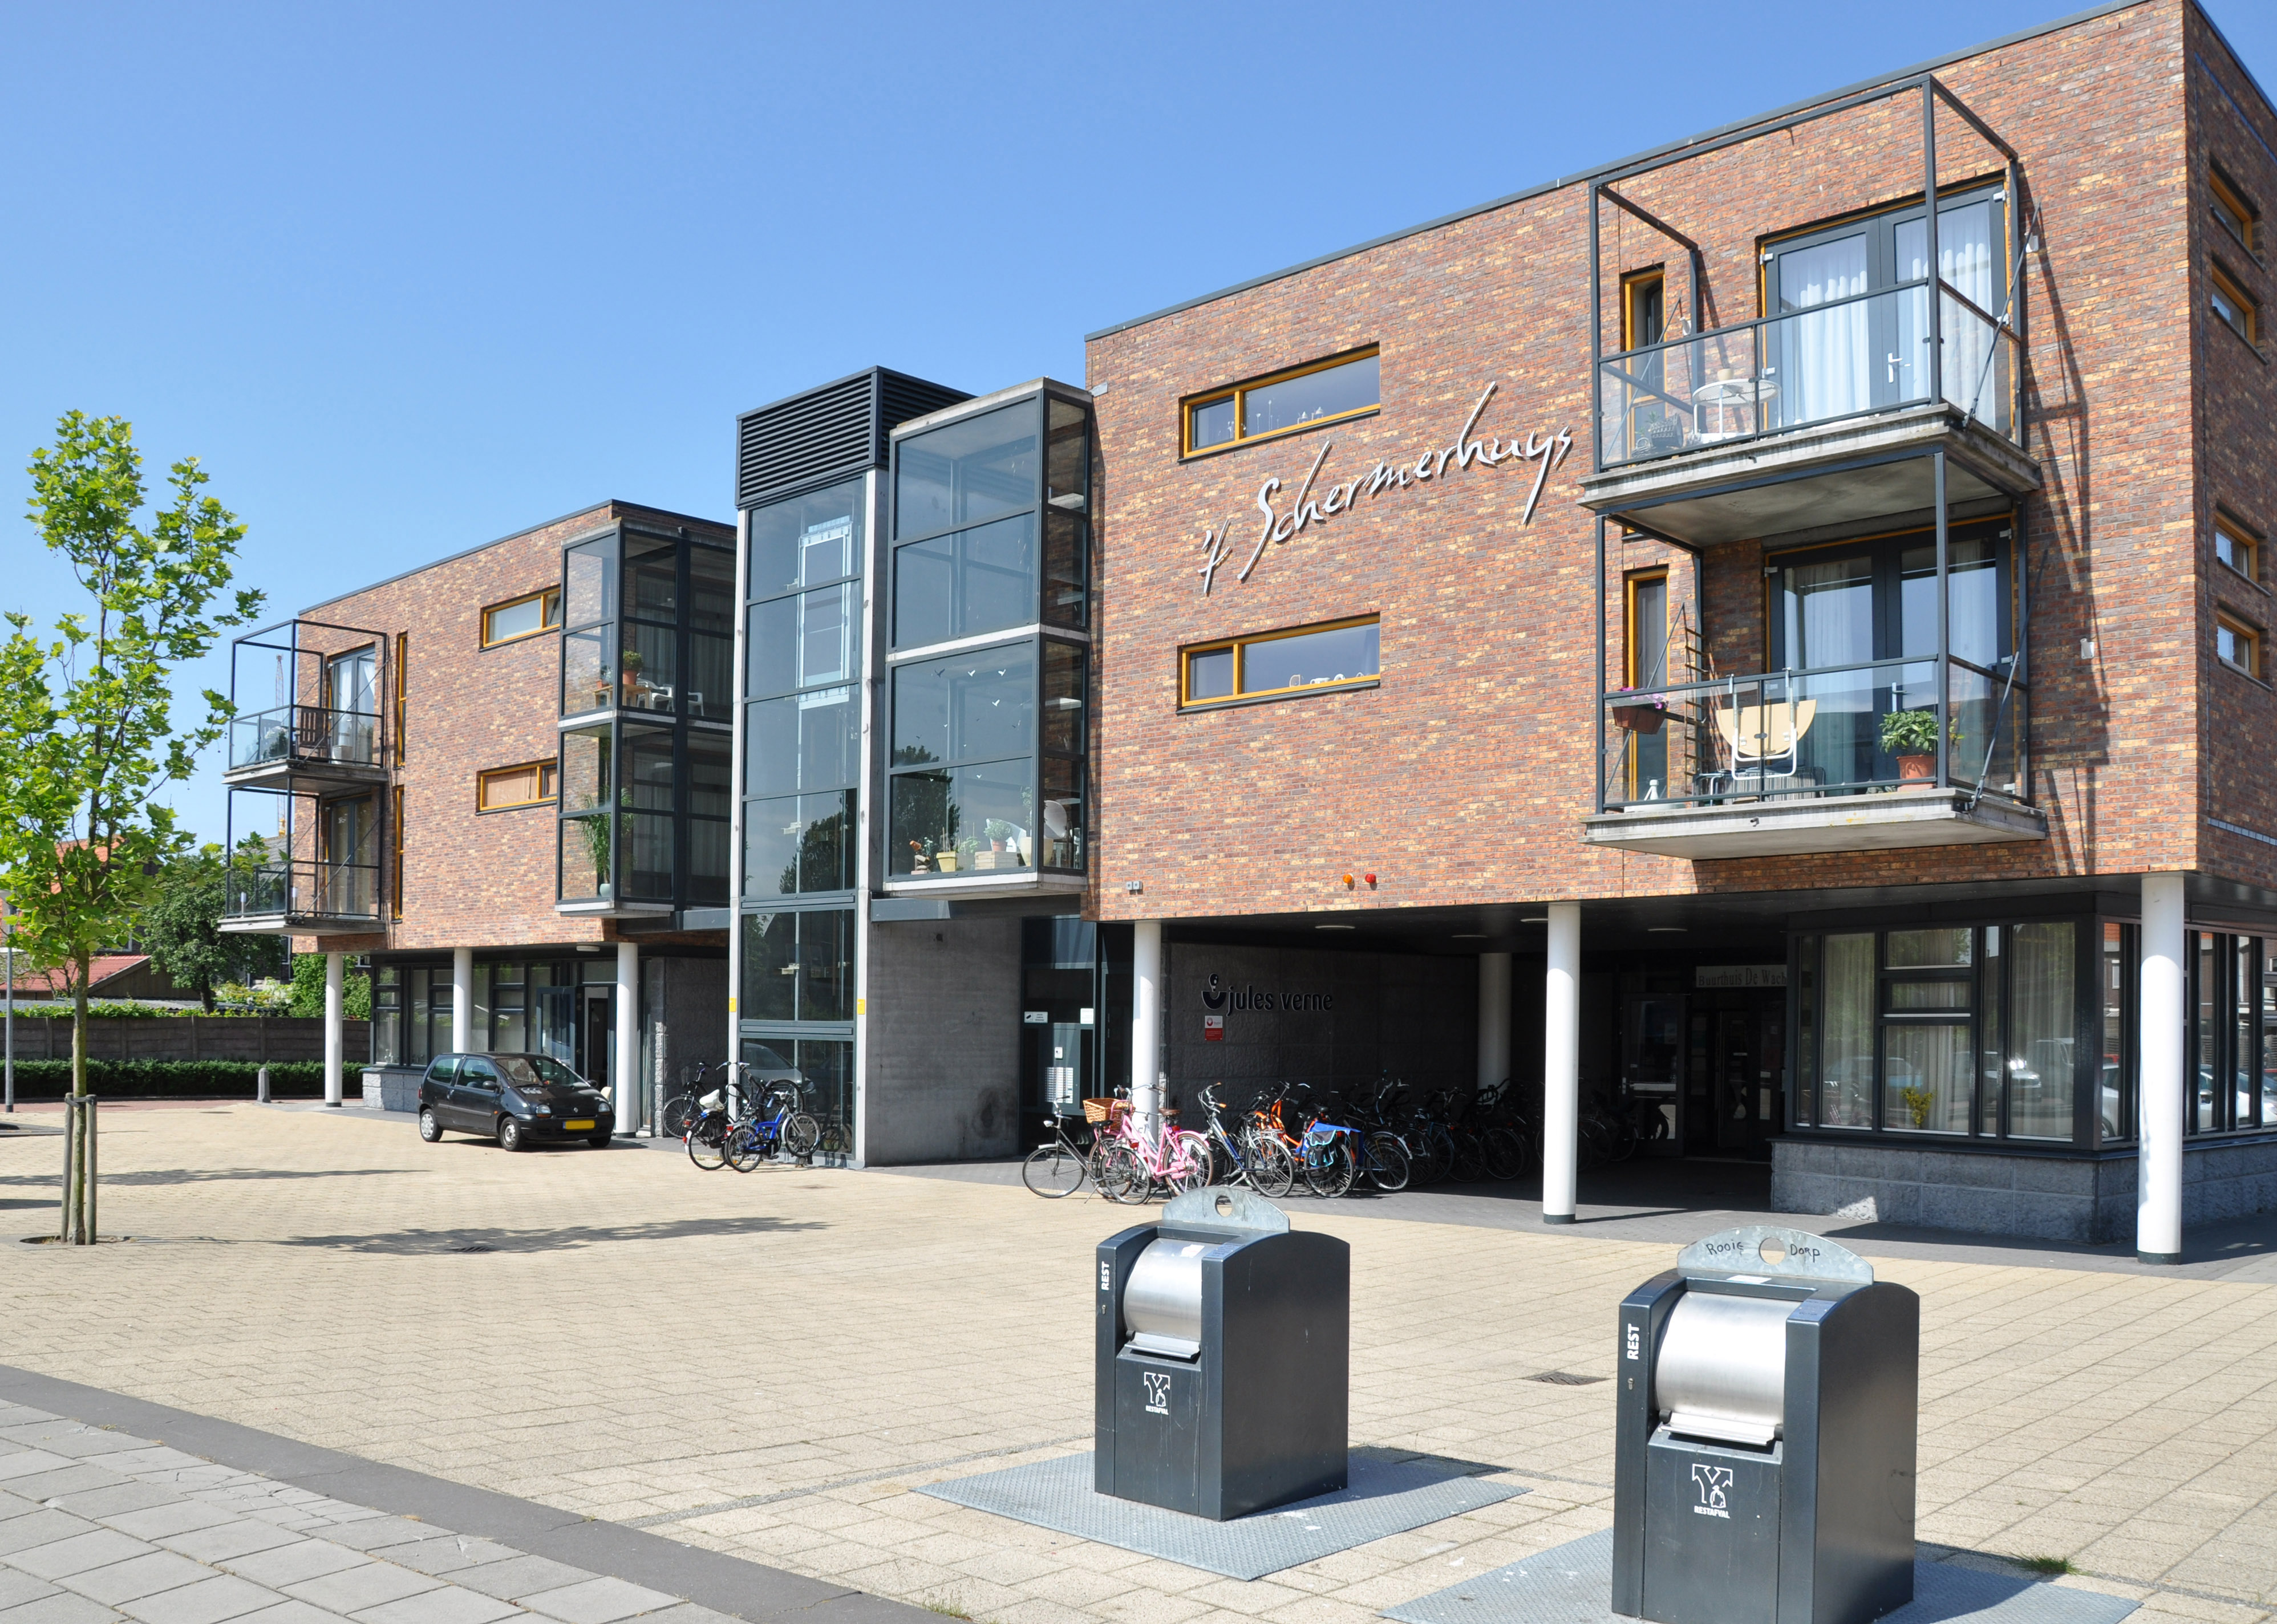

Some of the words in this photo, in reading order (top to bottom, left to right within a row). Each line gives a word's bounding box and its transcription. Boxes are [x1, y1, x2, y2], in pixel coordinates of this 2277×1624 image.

[1237, 381, 1572, 580] Schermerhuys
[1699, 969, 1742, 986] Buurthuis
[1745, 968, 1757, 985] De
[1226, 983, 1274, 1016] jules
[1279, 992, 1333, 1011] verne
[1627, 1323, 1639, 1360] REST
[1145, 1405, 1169, 1415] RESTAFVAL
[1694, 1505, 1730, 1519] RESTAFVAL
